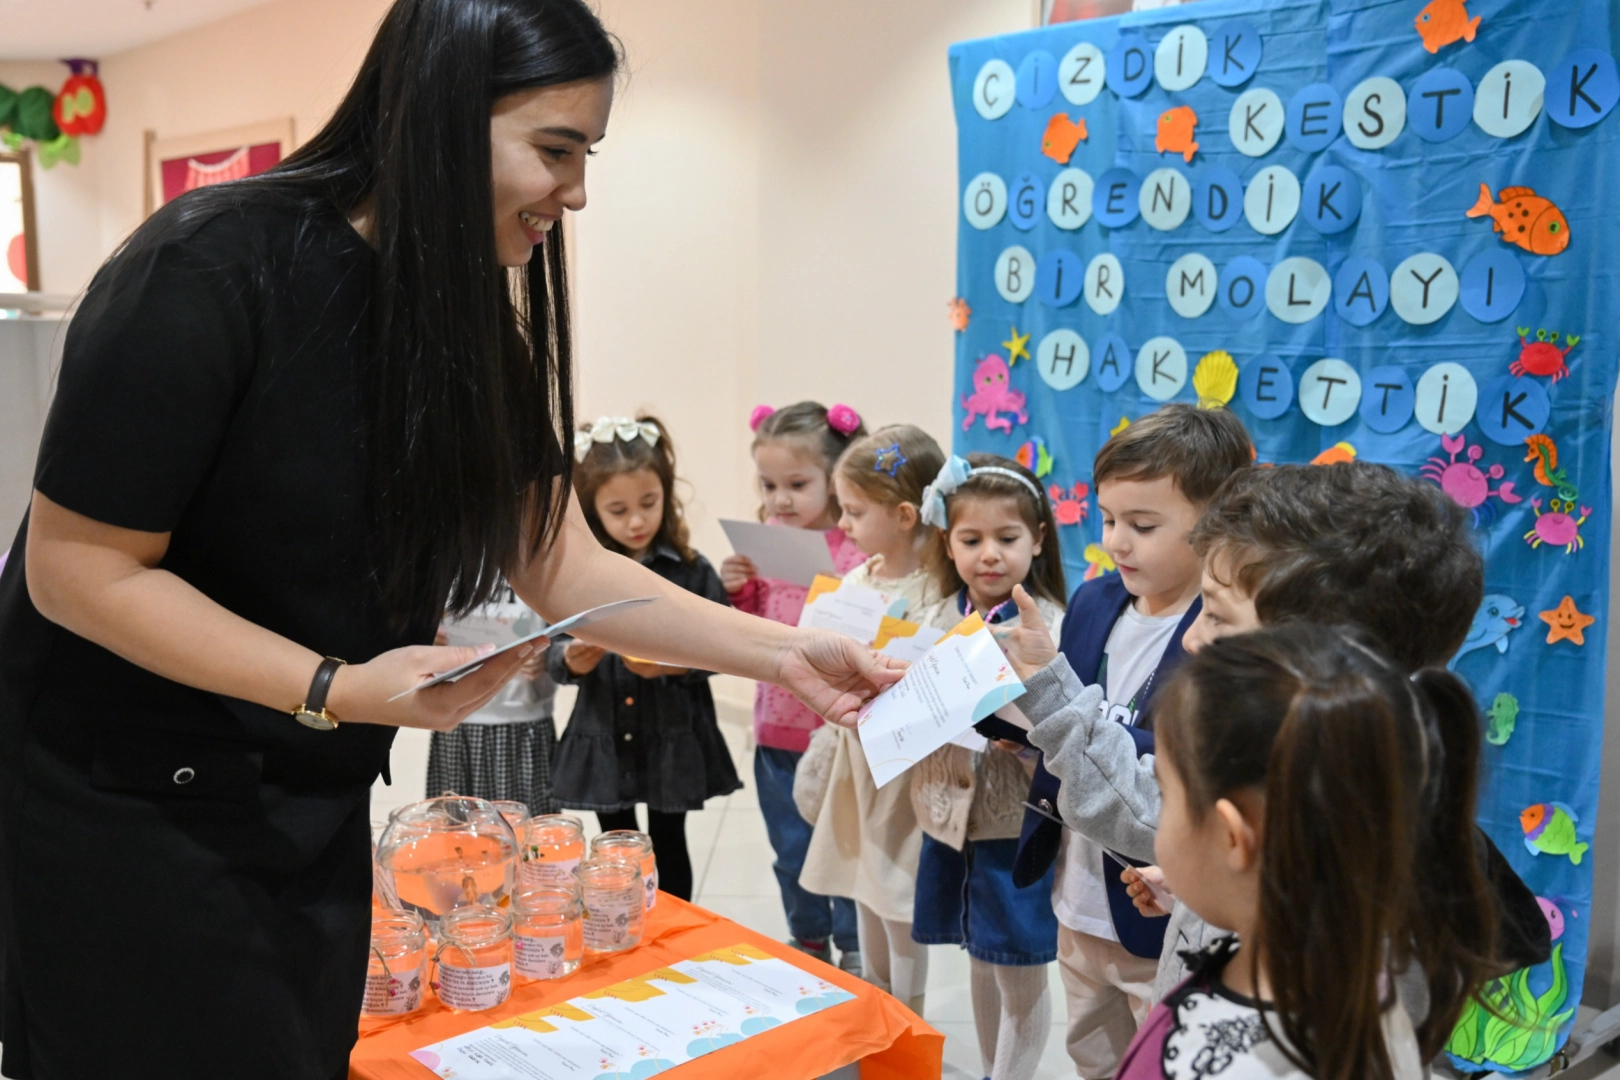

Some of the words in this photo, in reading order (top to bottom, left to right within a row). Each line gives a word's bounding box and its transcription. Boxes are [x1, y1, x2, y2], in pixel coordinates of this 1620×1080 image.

[982, 33, 1247, 108] ÇİZDİK
[1243, 64, 1603, 143] KESTİK
[974, 173, 1343, 222] ÖĞRENDİK
[1006, 256, 1112, 300] BİR
[1180, 266, 1494, 313] MOLAYI
[1051, 343, 1177, 385] HAK
[1256, 366, 1536, 432] ETTİK
